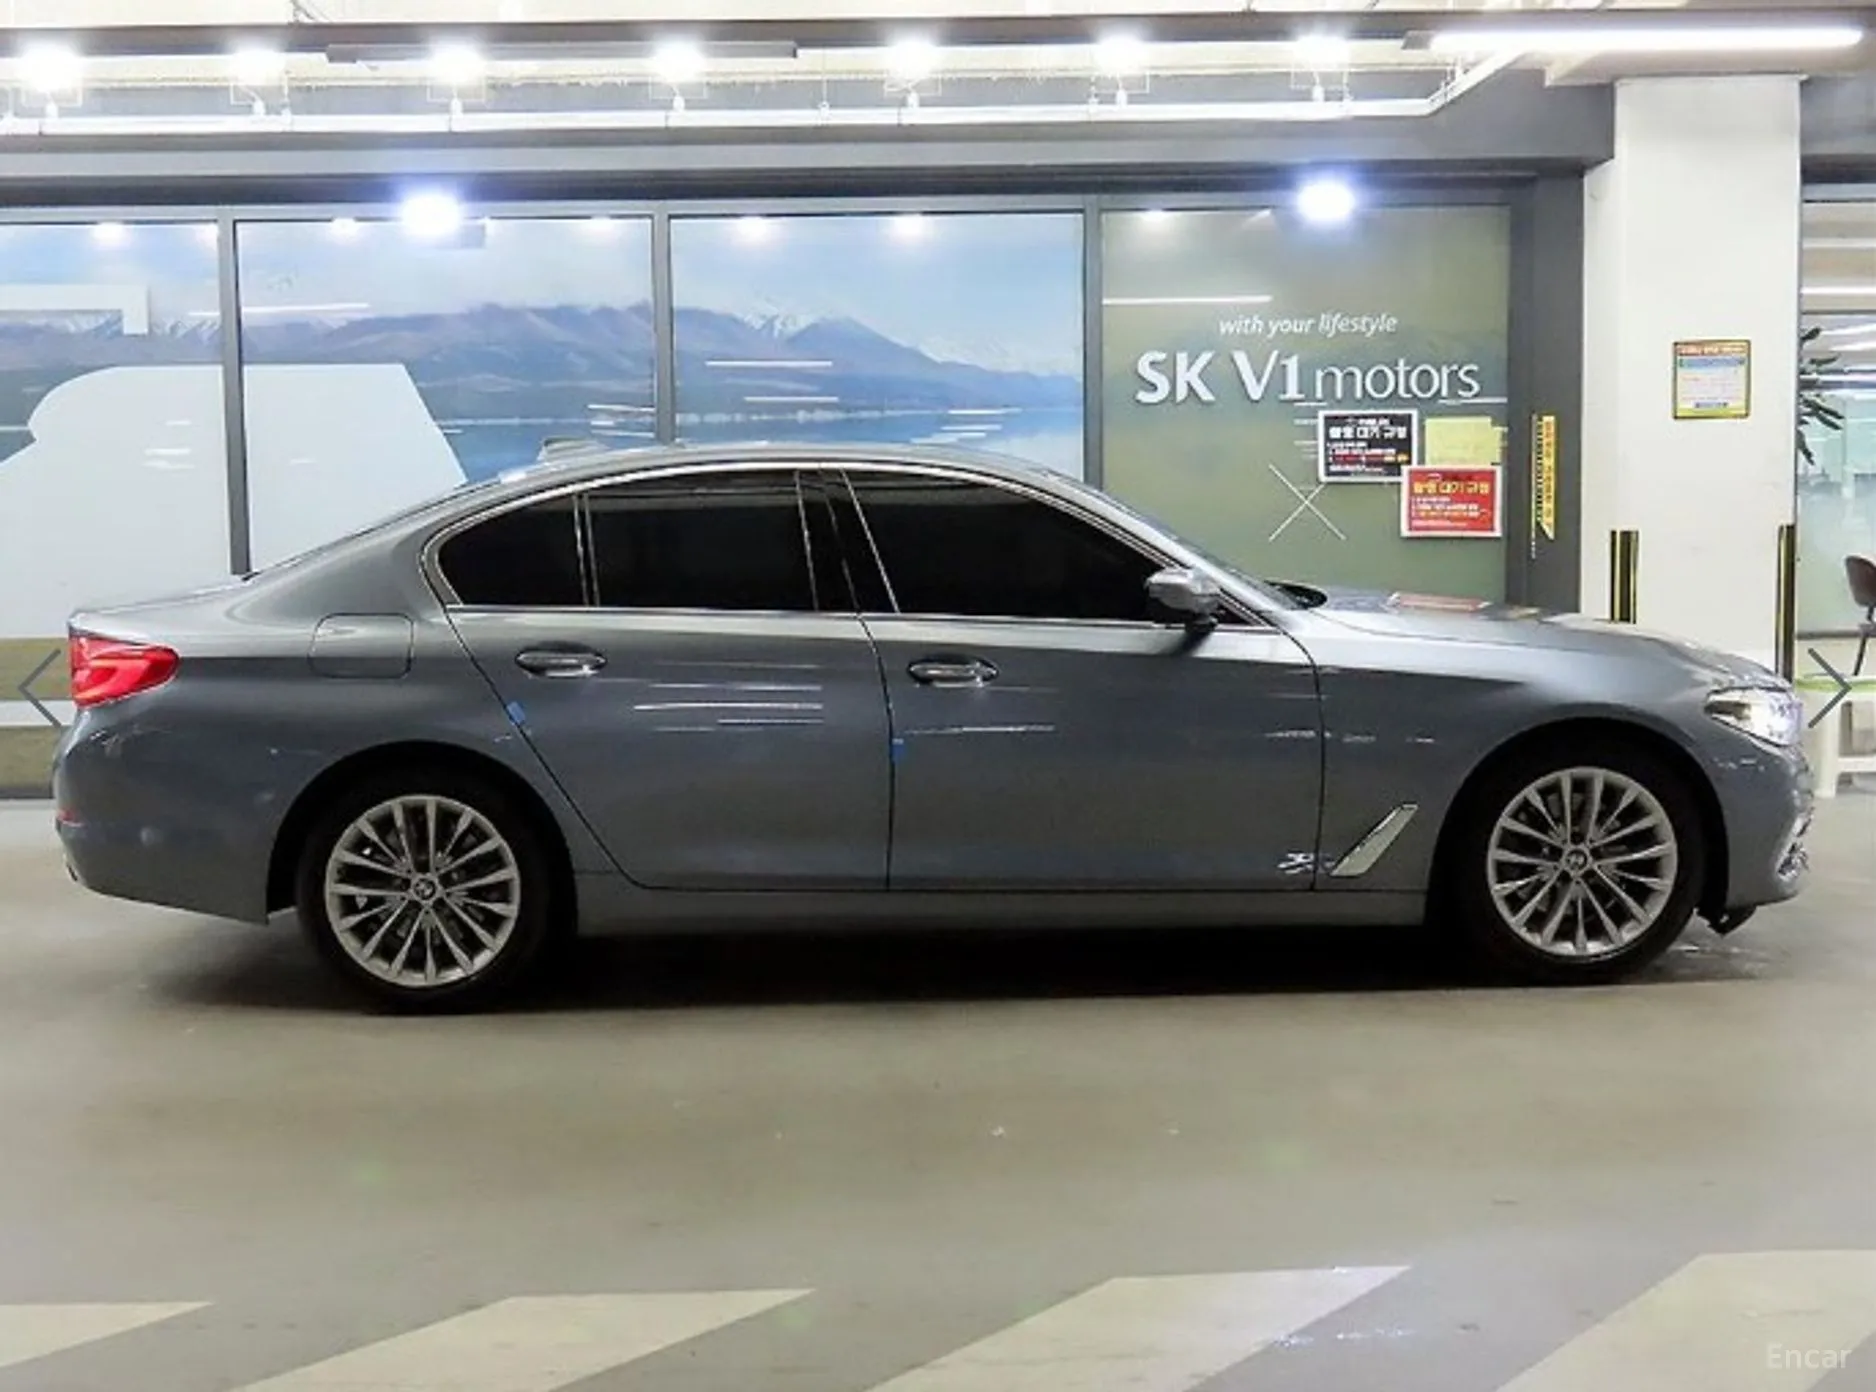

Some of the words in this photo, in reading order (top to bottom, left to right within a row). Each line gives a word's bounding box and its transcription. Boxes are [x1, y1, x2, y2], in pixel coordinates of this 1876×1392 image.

[1219, 315, 1264, 335] with
[1267, 319, 1315, 338] your
[1318, 313, 1398, 338] lifestyle
[1135, 351, 1216, 402] SK
[1231, 350, 1305, 401] V1
[1315, 357, 1480, 399] motors
